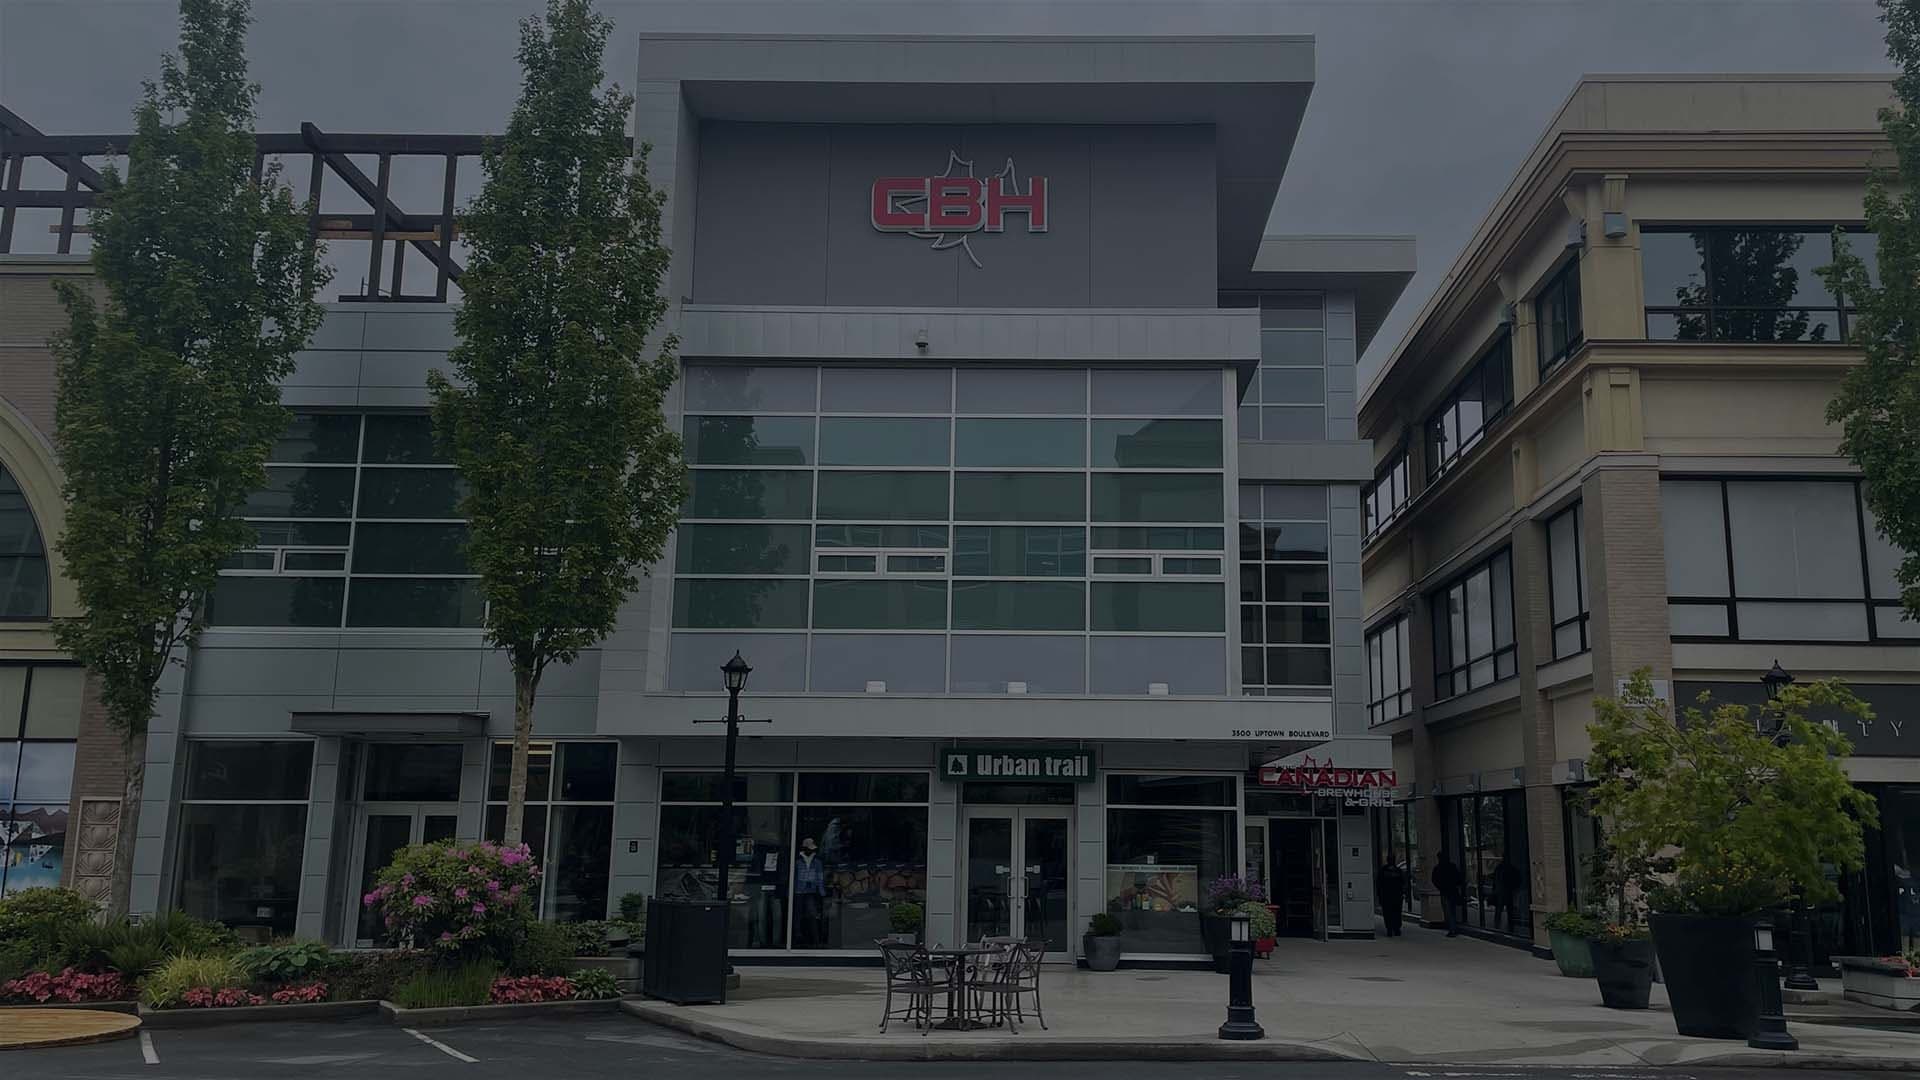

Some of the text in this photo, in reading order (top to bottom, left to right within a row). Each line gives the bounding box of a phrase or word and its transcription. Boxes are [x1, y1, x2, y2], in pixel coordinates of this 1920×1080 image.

[872, 176, 1048, 232] CBH
[1232, 729, 1330, 738] 3500 UPTOWN BOULEVARD
[976, 754, 1089, 777] Urban trail
[1257, 767, 1397, 787] CANADIAN
[1317, 788, 1400, 799] BREWHOUSE
